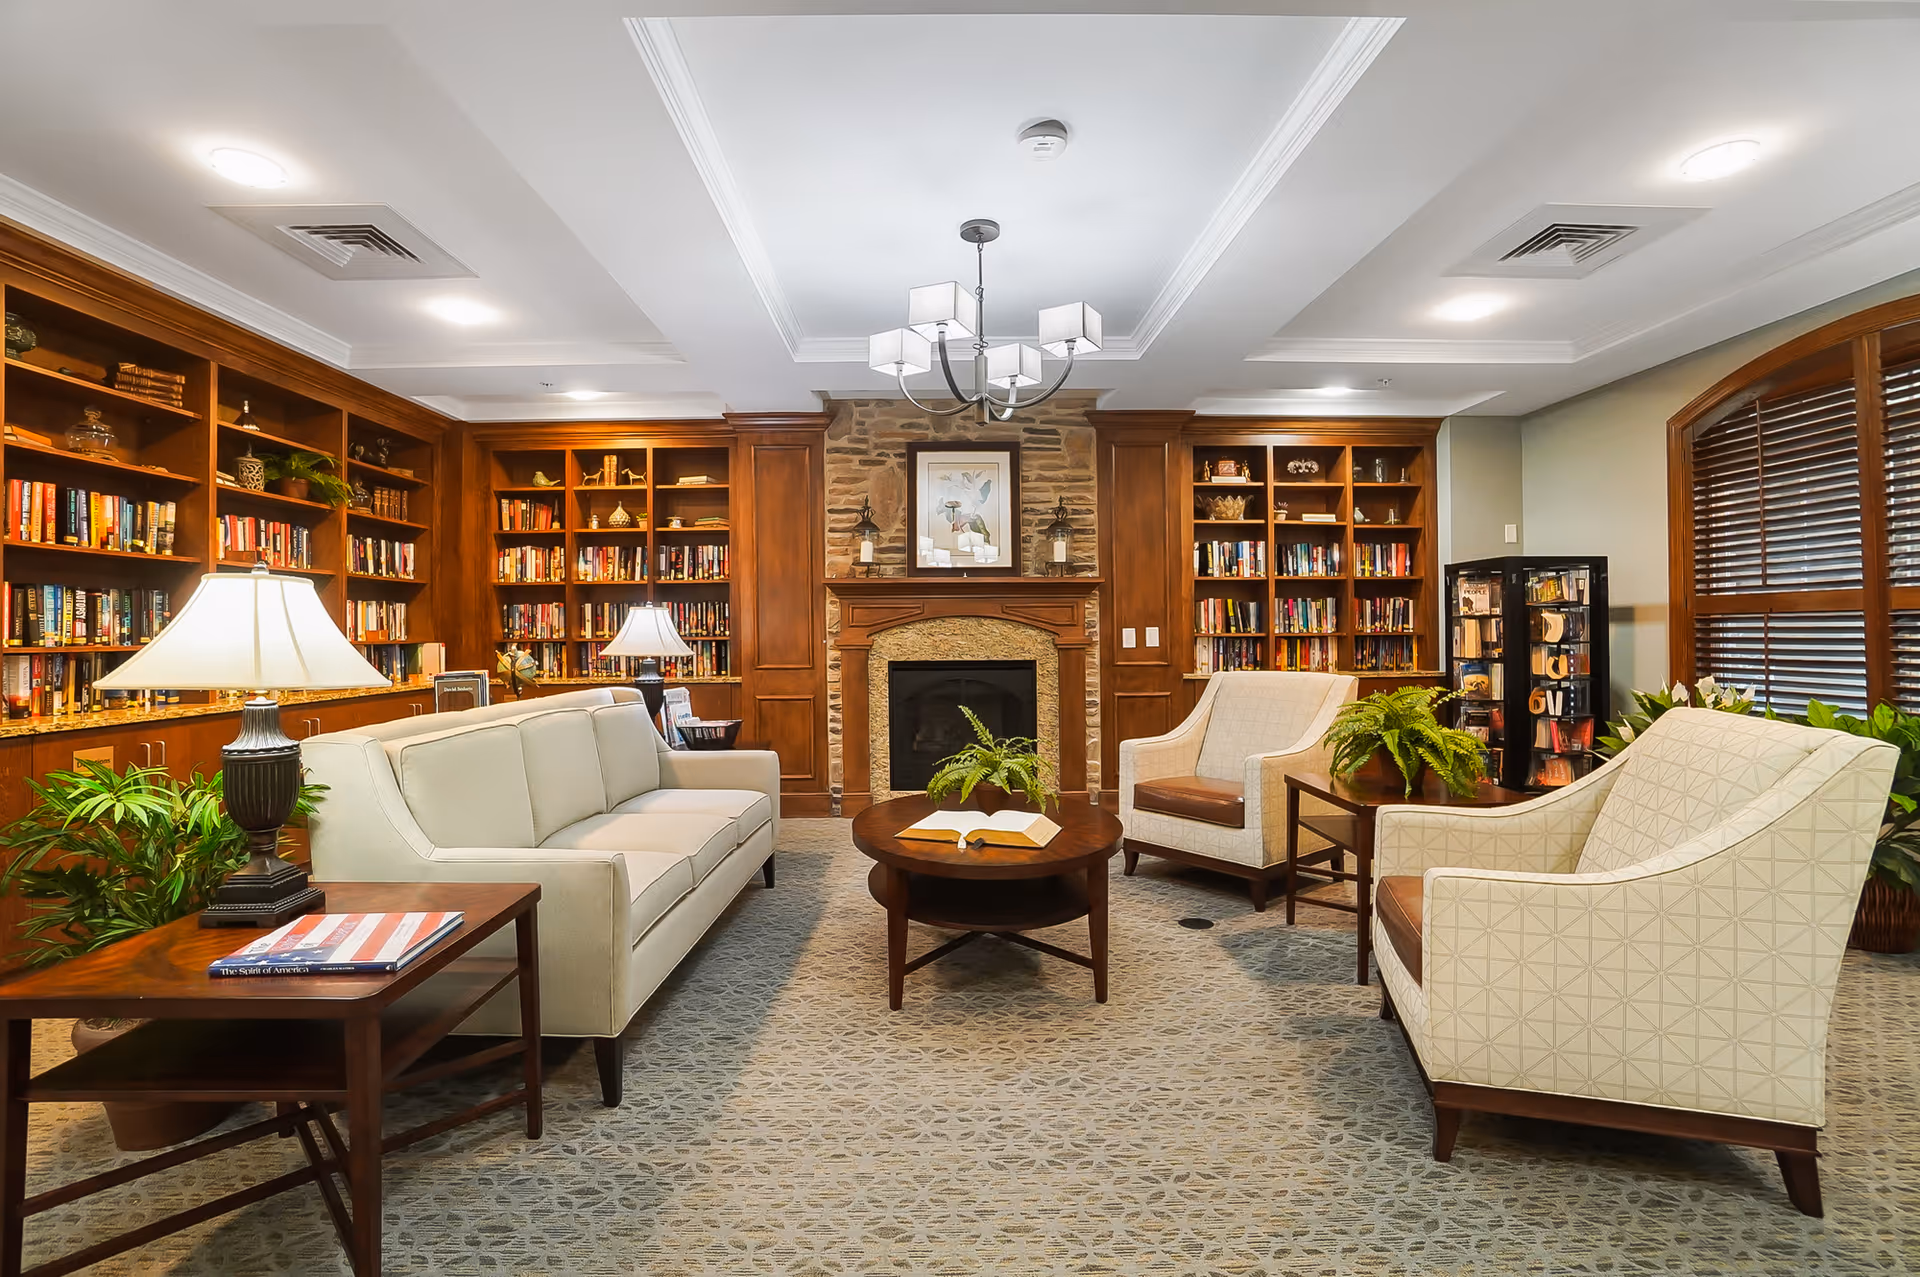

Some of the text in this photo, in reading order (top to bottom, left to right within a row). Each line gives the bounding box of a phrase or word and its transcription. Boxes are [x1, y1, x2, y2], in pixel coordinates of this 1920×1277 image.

[75, 589, 86, 619] AUTOPSY
[219, 968, 238, 976] The
[239, 967, 261, 976] Spirit
[262, 966, 272, 975] of
[273, 966, 310, 974] America
